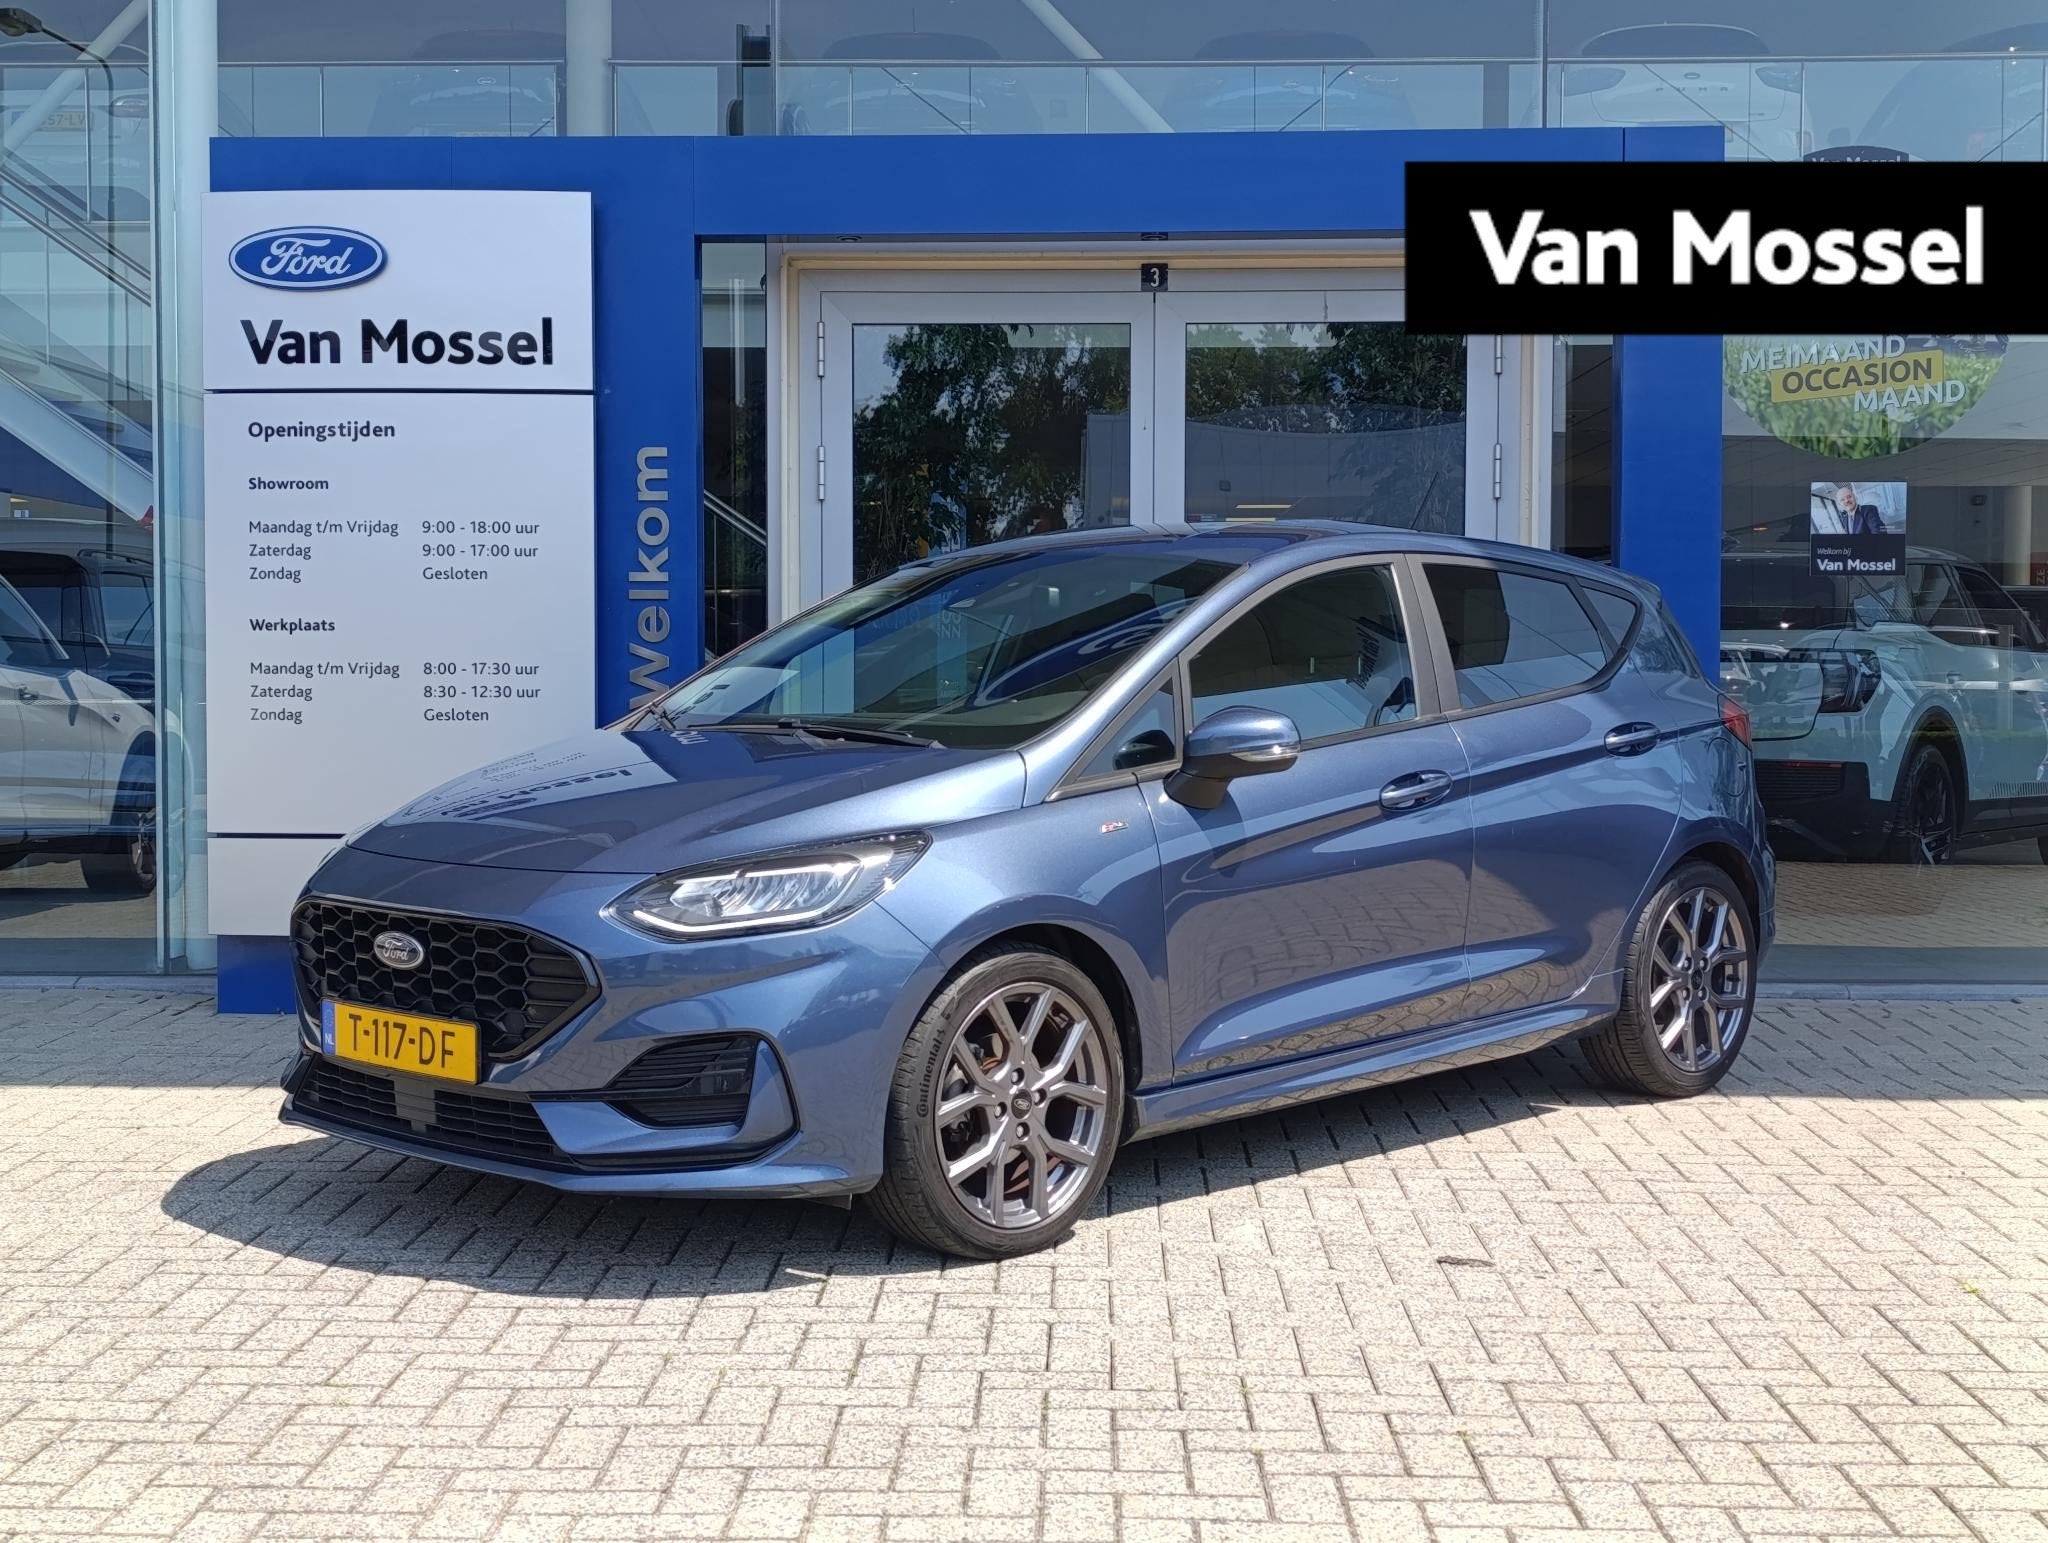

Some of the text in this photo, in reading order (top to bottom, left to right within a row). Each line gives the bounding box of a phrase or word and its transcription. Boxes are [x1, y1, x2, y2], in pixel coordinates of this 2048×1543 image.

[260, 236, 352, 276] Ford
[1149, 267, 1160, 288] 3
[240, 316, 554, 366] Van Mossel
[1742, 335, 1905, 374] MEIMAAND
[1782, 357, 1932, 394] OCCASION
[1854, 379, 1967, 412] MAAND
[248, 420, 395, 442] Openingstijden
[248, 476, 329, 490] Showroom
[249, 519, 399, 538] Maandag t/m Vrijdag
[422, 520, 456, 534] 9:00
[470, 520, 511, 534] 18:00
[515, 524, 540, 534] uur
[249, 543, 312, 561] Zaterdag
[422, 543, 456, 557] 9:00
[470, 543, 510, 557] 17:00
[514, 547, 539, 557] uur
[1816, 547, 1852, 557] Welkom bij
[422, 566, 488, 580] Gesloten
[1816, 558, 1896, 571] Van Mossel
[249, 566, 302, 584] Zondag
[628, 446, 671, 711] Welkom
[249, 617, 336, 636] Werkplaats
[250, 661, 400, 679] Maandag t/m Vrijdag
[423, 662, 457, 675] 8:00
[471, 662, 511, 676] 17:30
[515, 665, 540, 676] uur
[250, 684, 313, 702] Zaterdag
[423, 685, 457, 698] 8:30
[471, 685, 512, 698] 12:30
[516, 688, 541, 698] uur
[250, 707, 303, 725] Zondag
[423, 707, 489, 722] Gesloten
[324, 1032, 334, 1045] NL
[348, 1013, 456, 1069] T-117-DF
[916, 1036, 943, 1118] Continental
